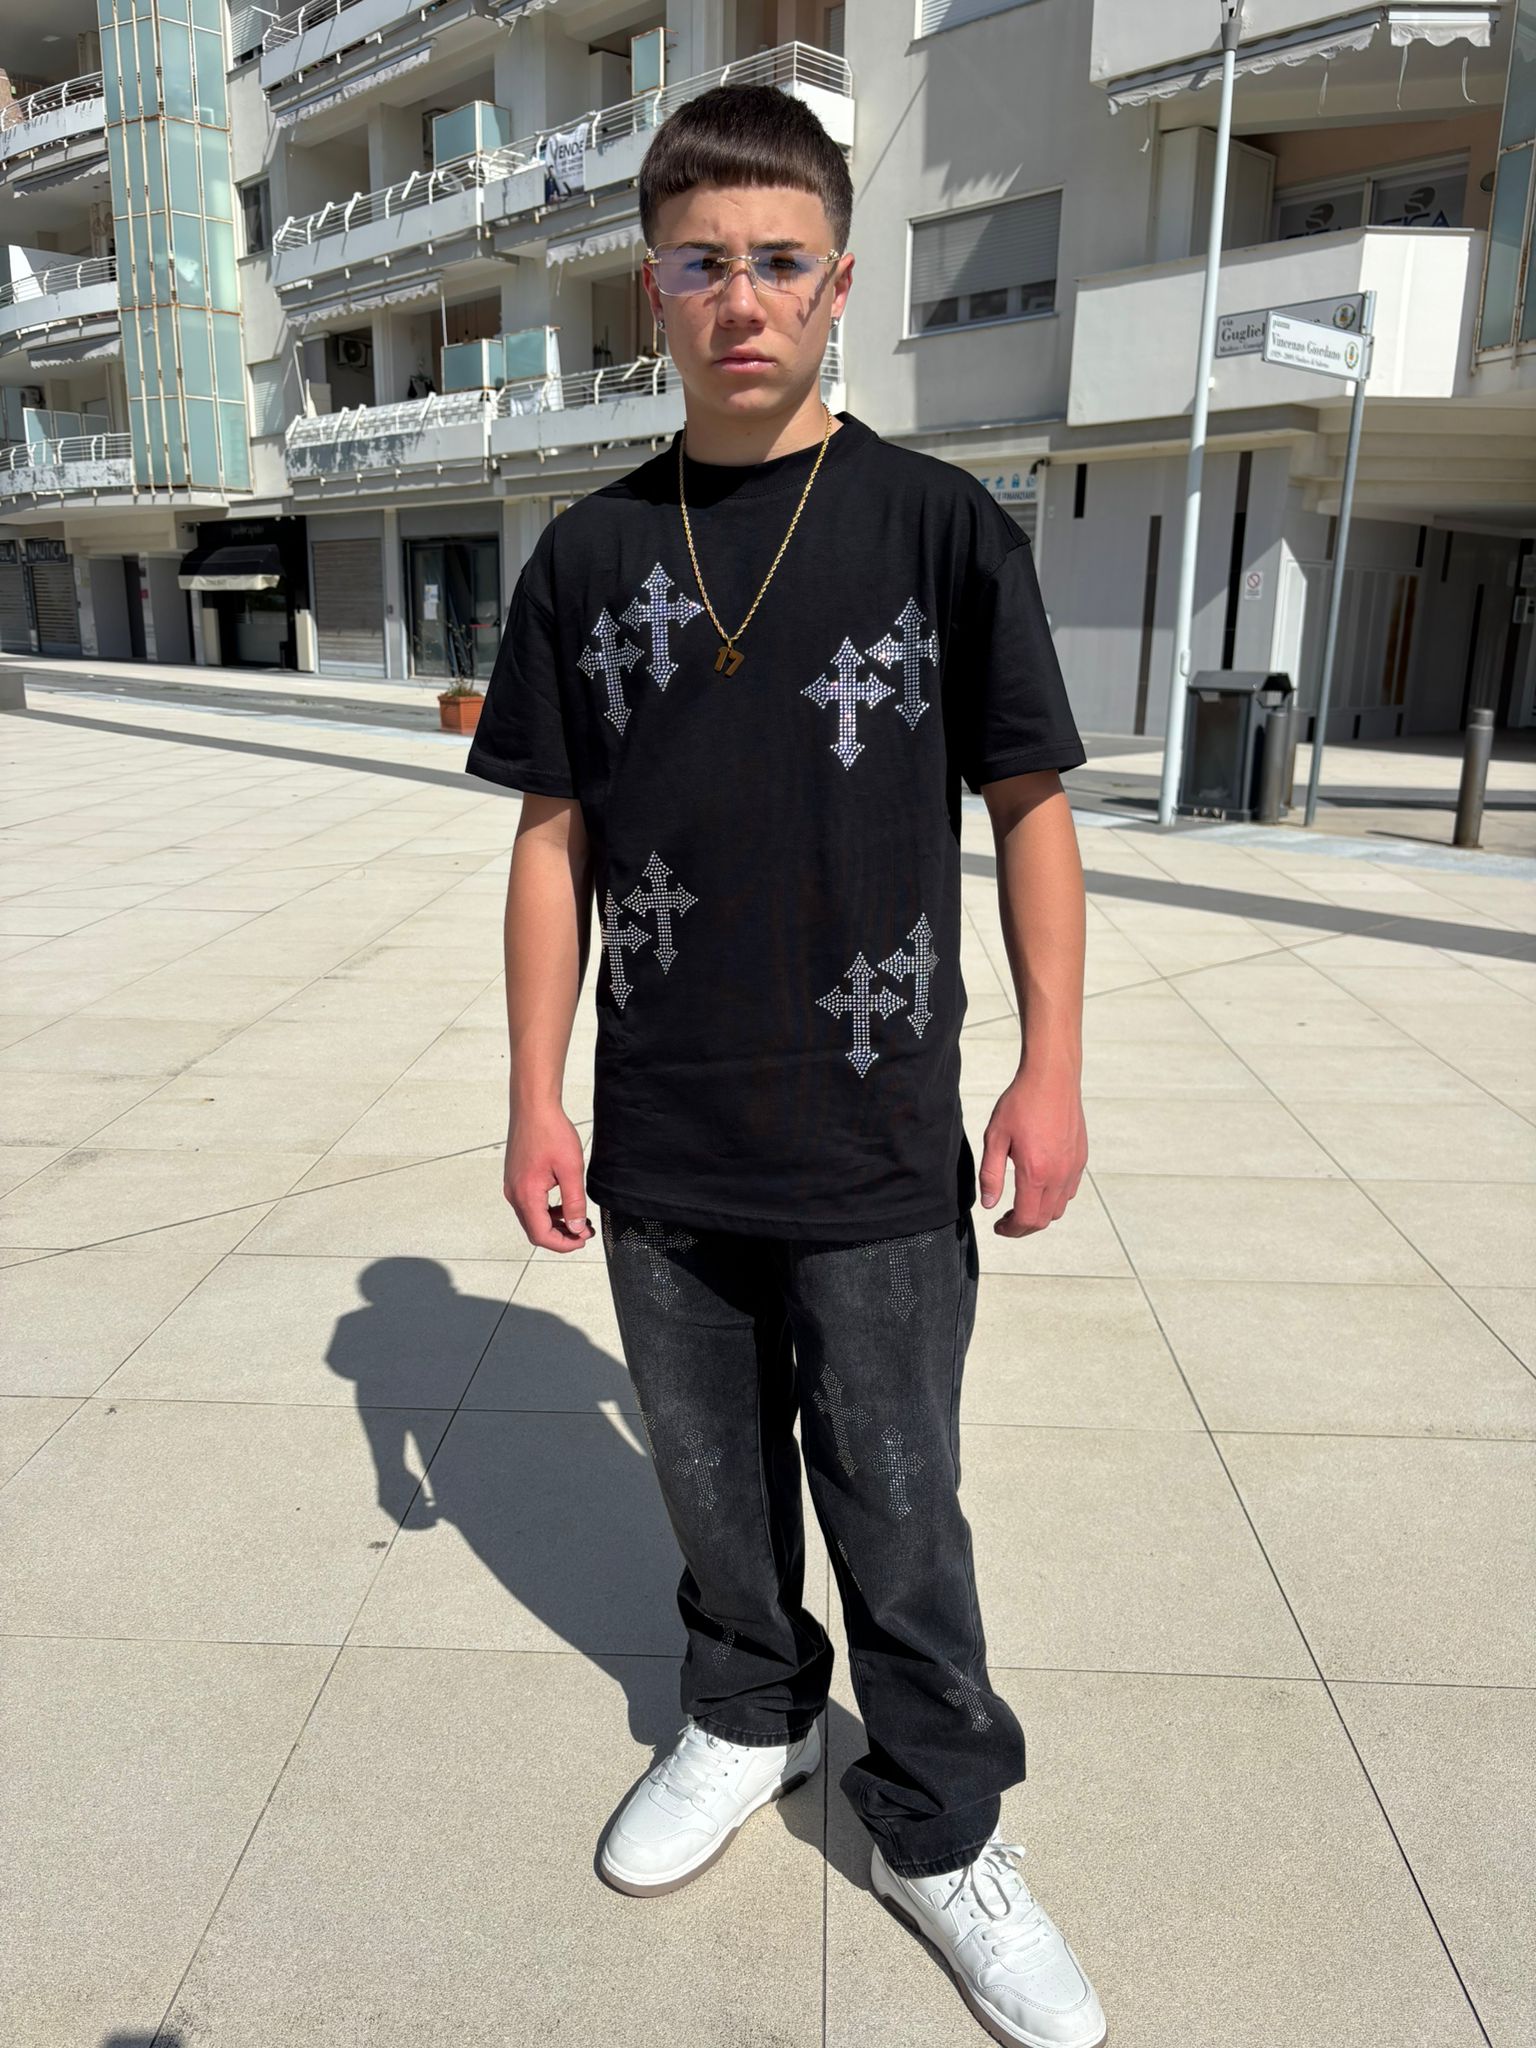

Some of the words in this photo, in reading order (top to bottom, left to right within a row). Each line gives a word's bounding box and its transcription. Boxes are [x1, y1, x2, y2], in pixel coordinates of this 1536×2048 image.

[1221, 322, 1266, 343] Gugliel
[1222, 318, 1234, 327] via
[1271, 331, 1306, 352] Vincenzo
[1307, 340, 1342, 360] Giordano
[27, 542, 66, 561] NAUTICA
